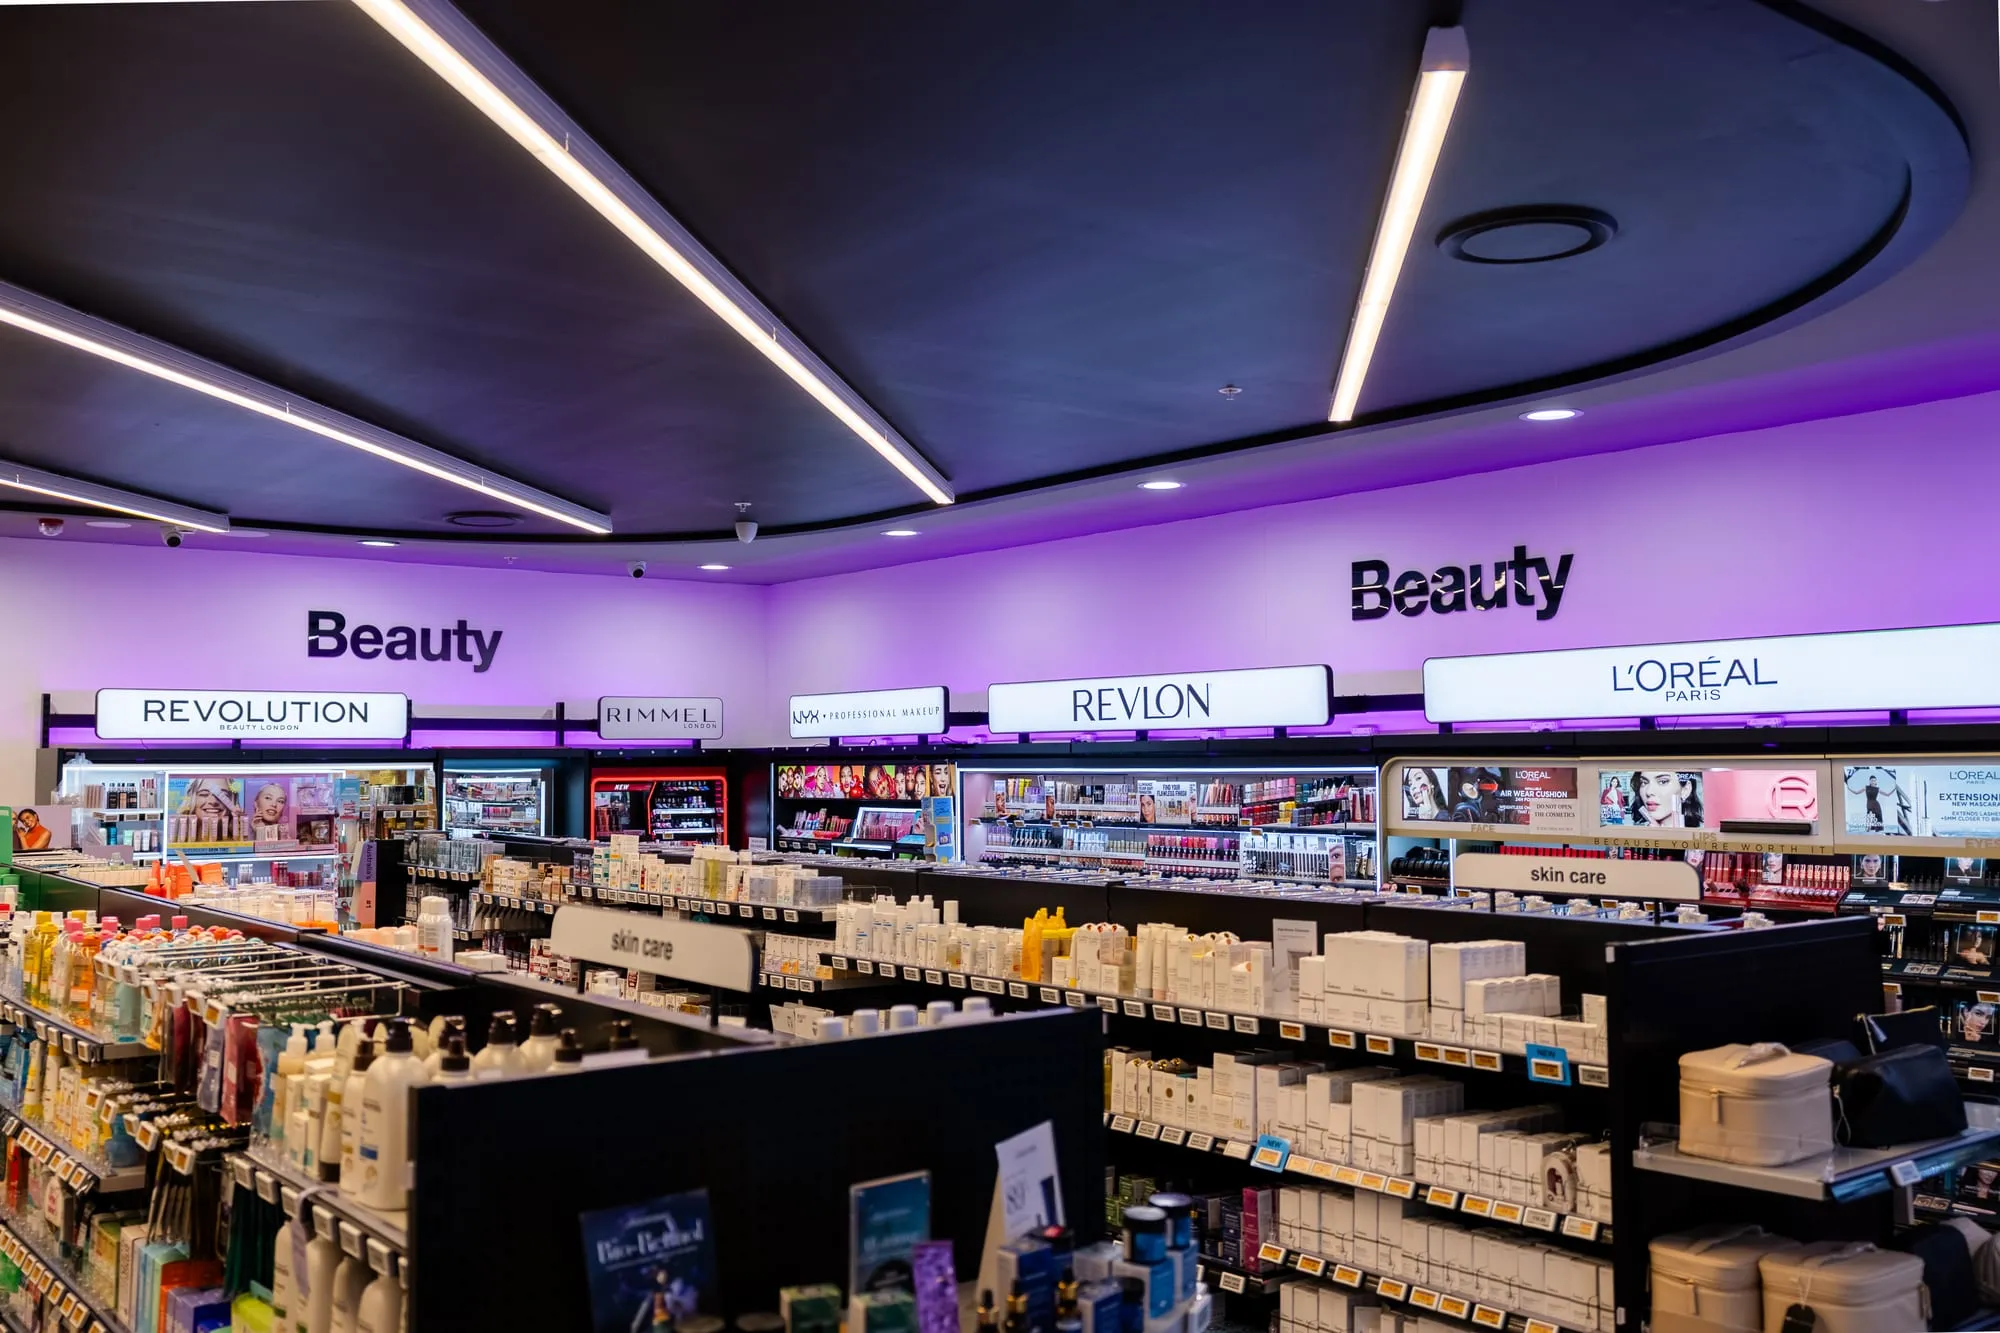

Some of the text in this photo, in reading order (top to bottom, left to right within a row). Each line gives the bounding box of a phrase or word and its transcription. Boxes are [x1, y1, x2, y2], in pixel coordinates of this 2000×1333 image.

[1351, 546, 1573, 620] Beauty
[307, 611, 502, 673] Beauty
[1612, 656, 1778, 692] L'ORÉAL
[1073, 682, 1210, 721] REVLON
[143, 700, 368, 723] REVOLUTION
[607, 707, 716, 723] RIMMEL
[793, 706, 940, 724] NYX PROFESSIONAL MAKEUP
[1535, 790, 1568, 798] CUSHION
[1471, 824, 1496, 833] FACE
[1692, 832, 1717, 842] LIPS
[1594, 838, 1825, 854] BECAUSE YOU'RE WORTH IT
[365, 844, 374, 880] Australia's
[1530, 866, 1607, 885] skin care
[611, 928, 674, 961] skin care
[1266, 1139, 1282, 1149] NEW
